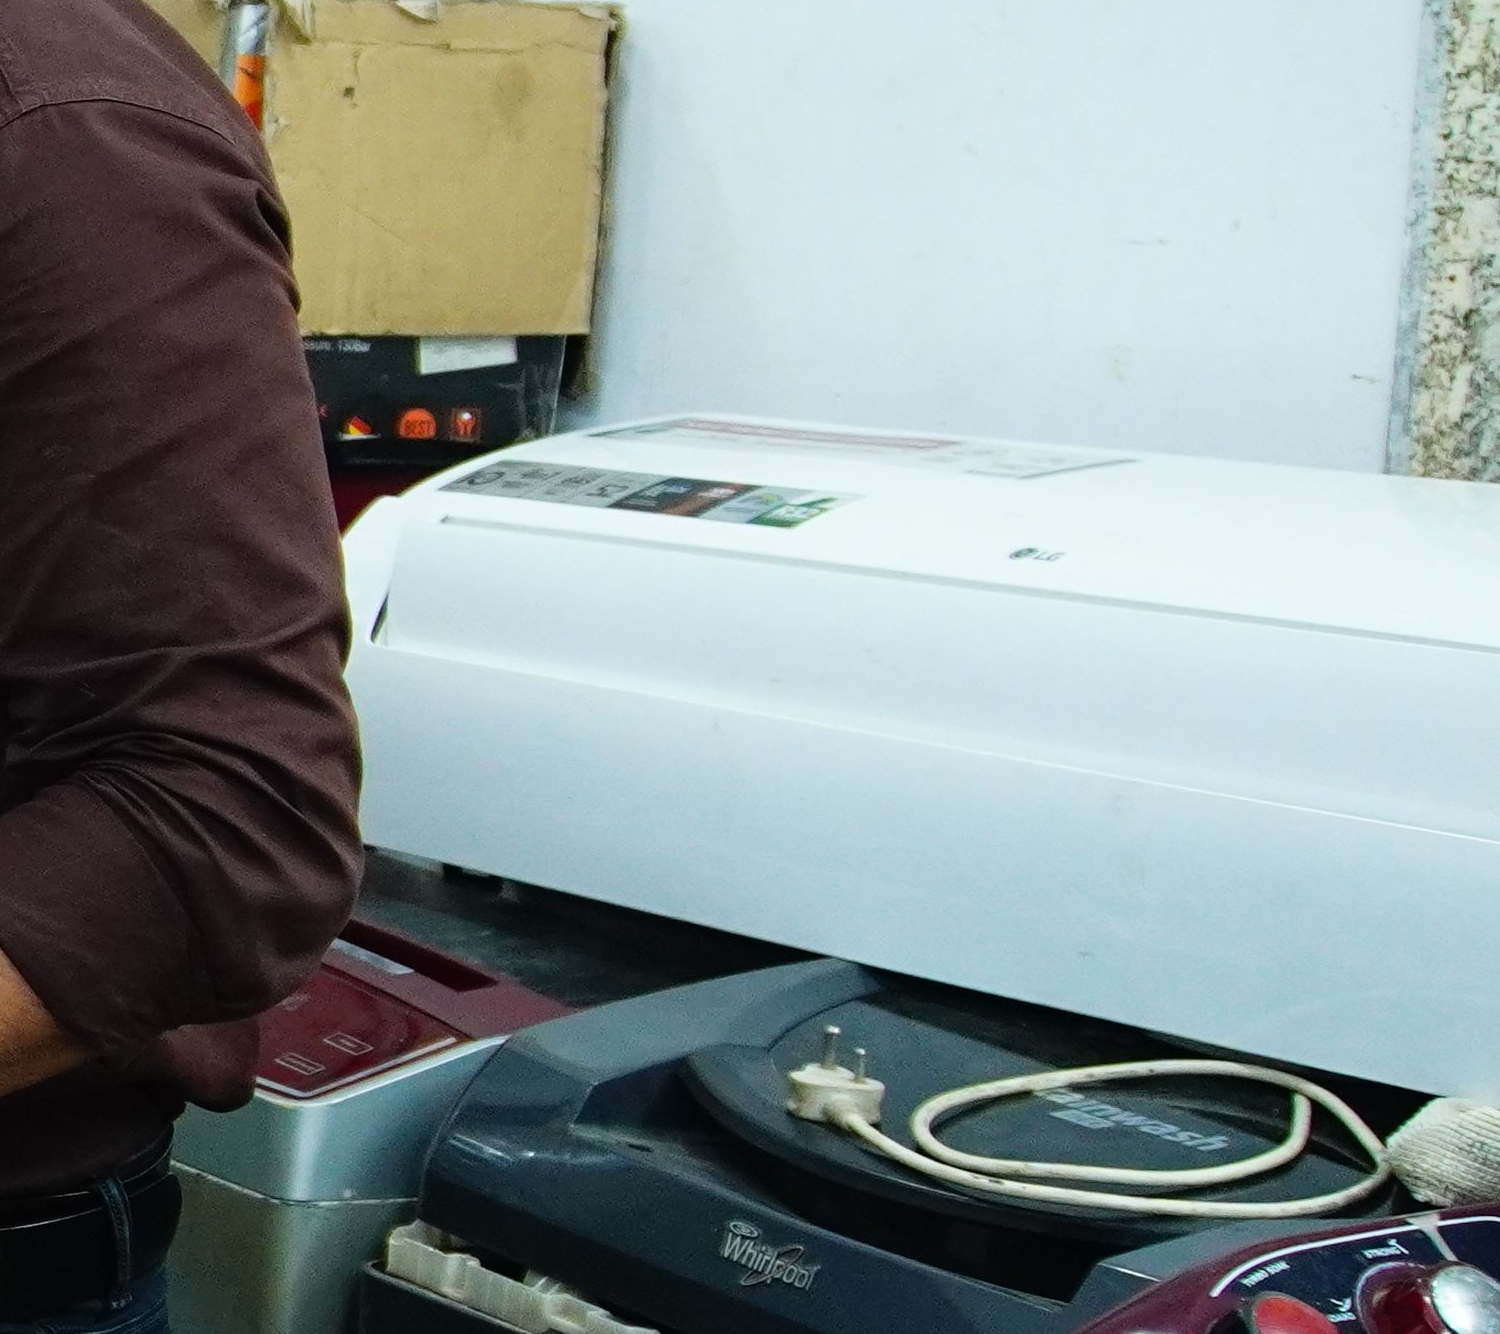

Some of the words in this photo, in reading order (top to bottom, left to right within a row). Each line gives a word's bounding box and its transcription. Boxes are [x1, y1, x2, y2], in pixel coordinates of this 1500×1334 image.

[1034, 550, 1065, 561] LG
[1035, 1088, 1230, 1152] amwash
[722, 1231, 821, 1291] Whirlpool
